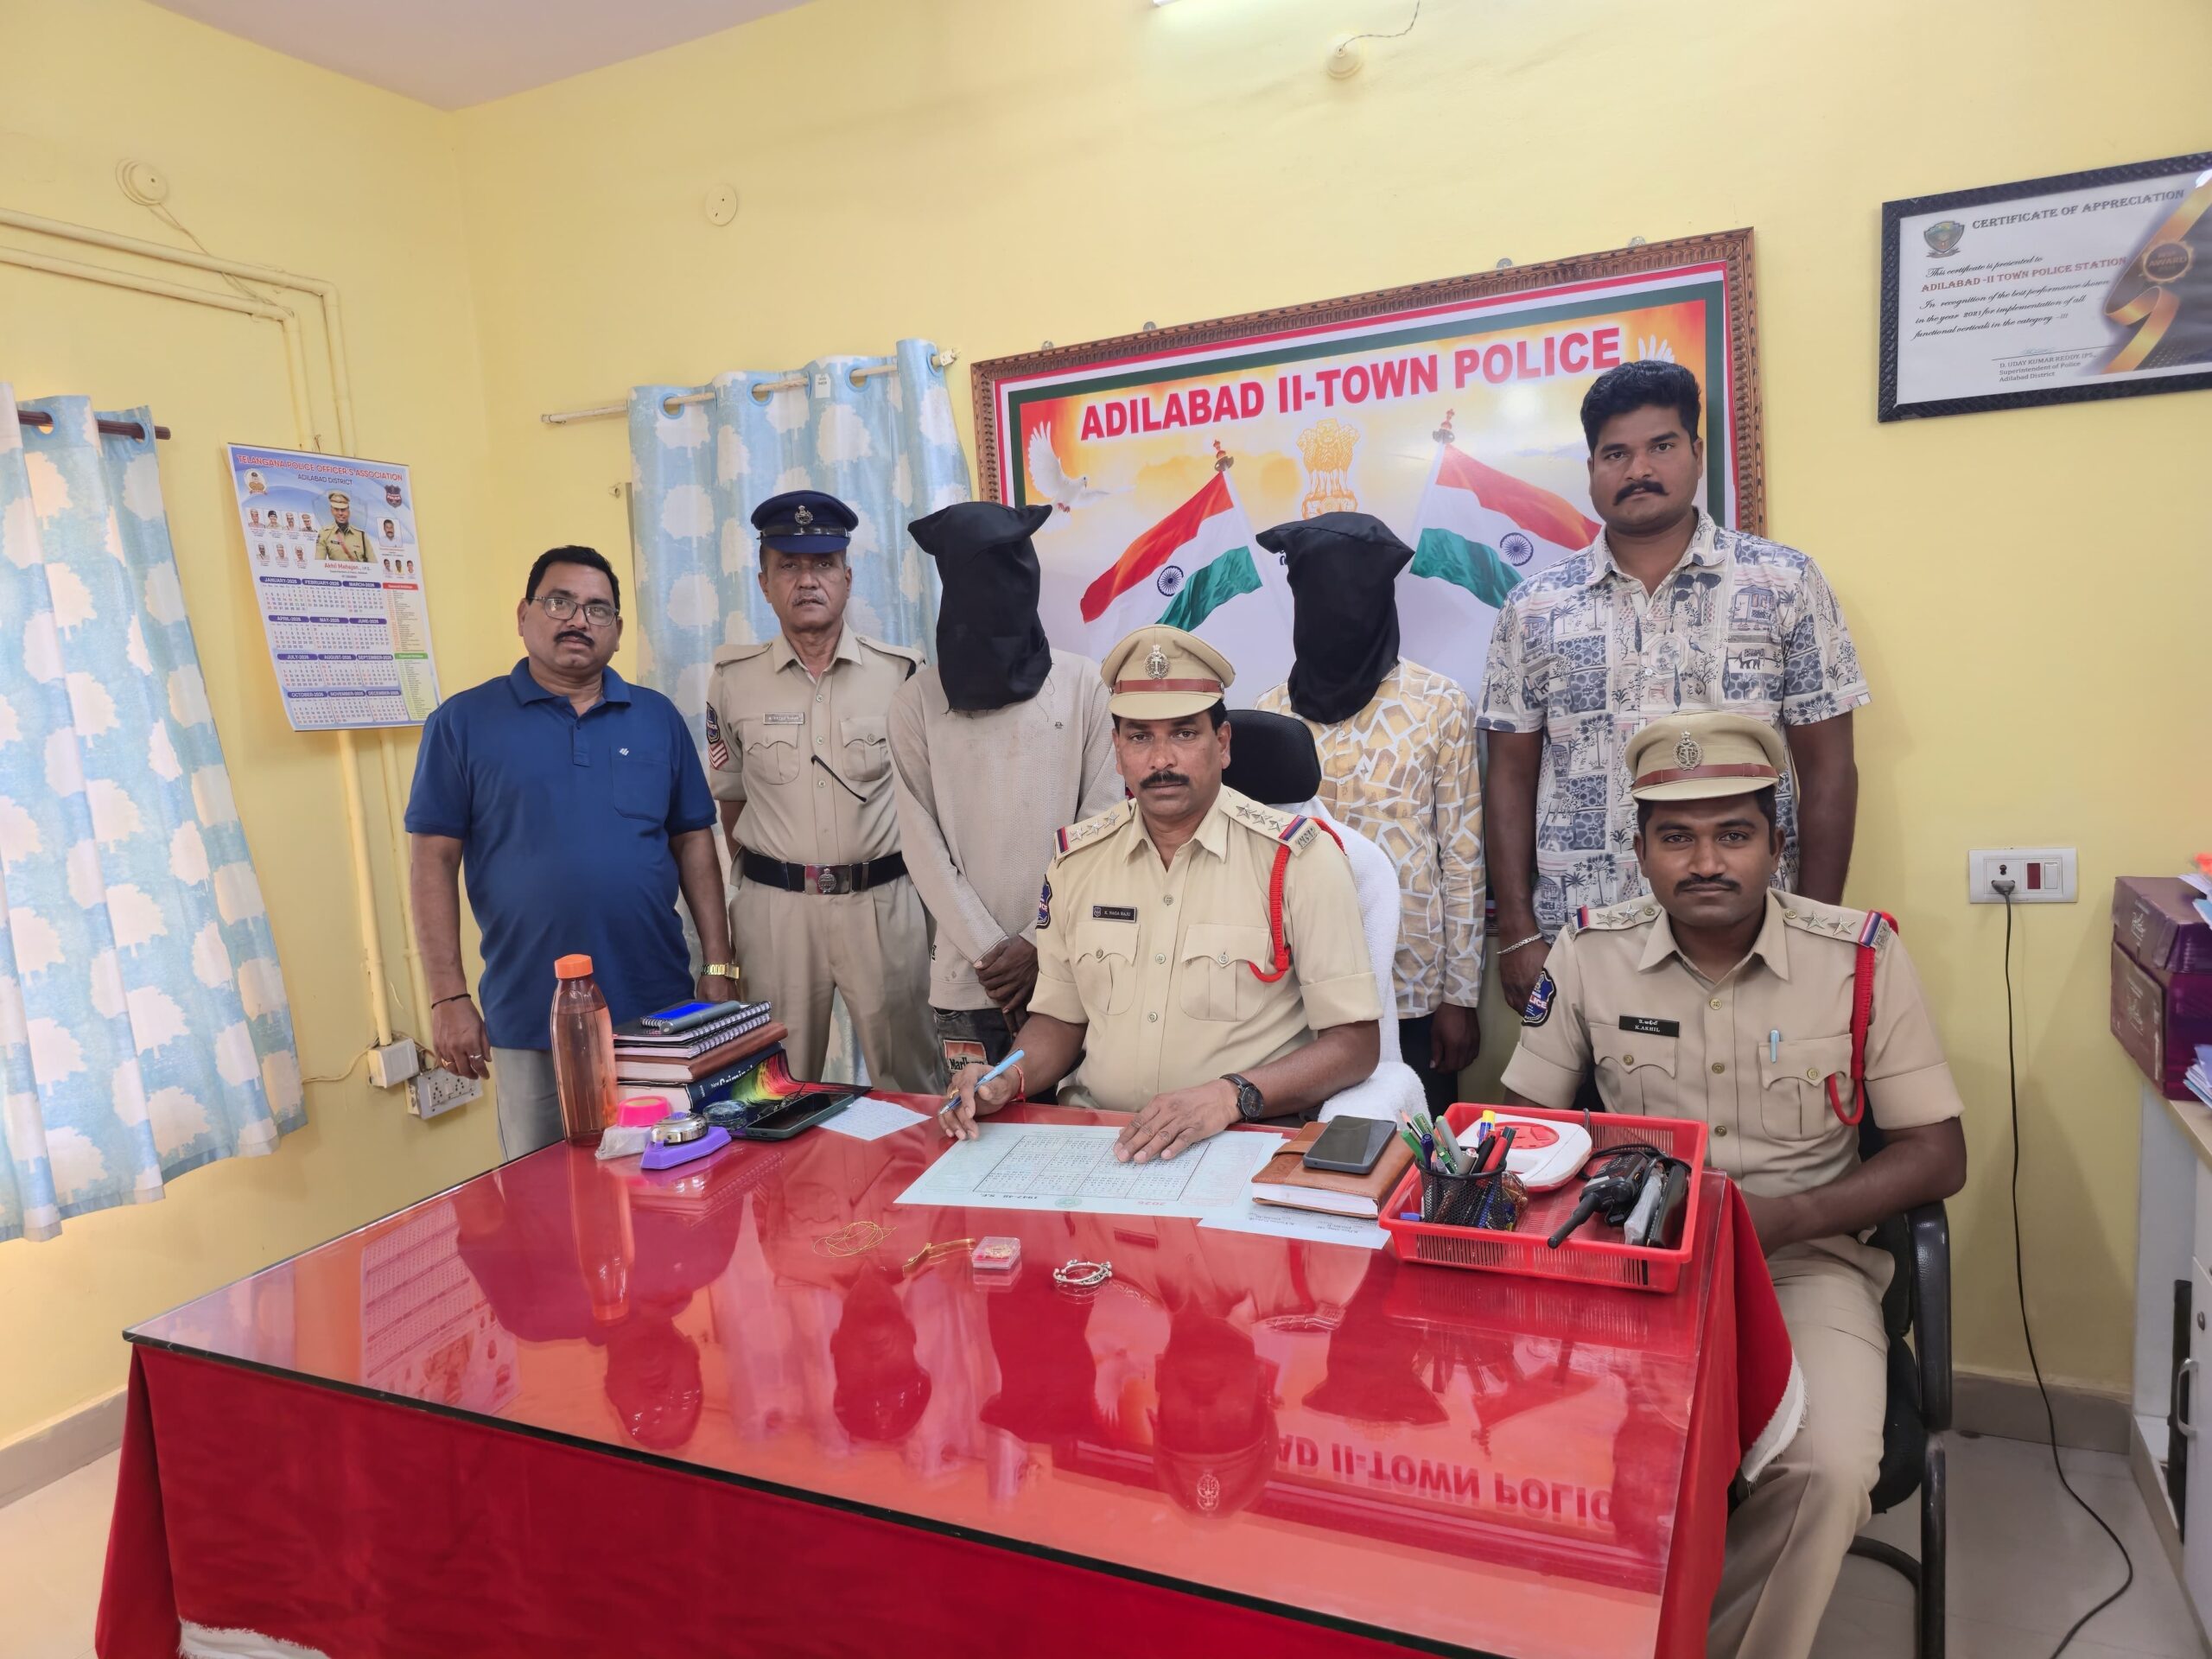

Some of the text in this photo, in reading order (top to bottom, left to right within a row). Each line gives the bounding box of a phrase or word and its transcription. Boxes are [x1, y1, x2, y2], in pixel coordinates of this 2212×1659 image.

[1972, 189, 2184, 229] CERTIFICATE OF APPRECIATION
[1921, 277, 1980, 292] ADILABAD
[1997, 270, 2029, 282] TOWN
[2031, 264, 2073, 277] POLICE
[2075, 257, 2127, 271] STATION
[1926, 266, 1946, 277] This
[1947, 264, 1985, 276] certificate
[1992, 256, 2034, 271] presented
[1919, 299, 1936, 309] In
[1941, 296, 1986, 308] recognition
[1987, 292, 1999, 302] of
[1997, 290, 2010, 299] the
[2024, 286, 2082, 298] performance
[2082, 279, 2110, 289] shown
[1937, 314, 1959, 325] year
[1979, 307, 1995, 319] for
[1996, 301, 2063, 315] implementation
[2062, 296, 2075, 307] of
[2073, 295, 2087, 303] all
[1911, 326, 1957, 340] functional
[1956, 321, 1990, 332] verticals
[2017, 315, 2053, 327] category
[1999, 365, 2051, 375] Superintendent
[2028, 357, 2055, 365] KUMAR
[1080, 327, 1621, 441] ADILABAD II-TOWN POLICE
[1999, 373, 2029, 383] Adilabad
[237, 454, 403, 481] TELANGANA POLICE OFFICER'S ASSOCIATION
[297, 474, 353, 486] ADILABAD DISTRICT
[1529, 995, 1548, 1009] LICE
